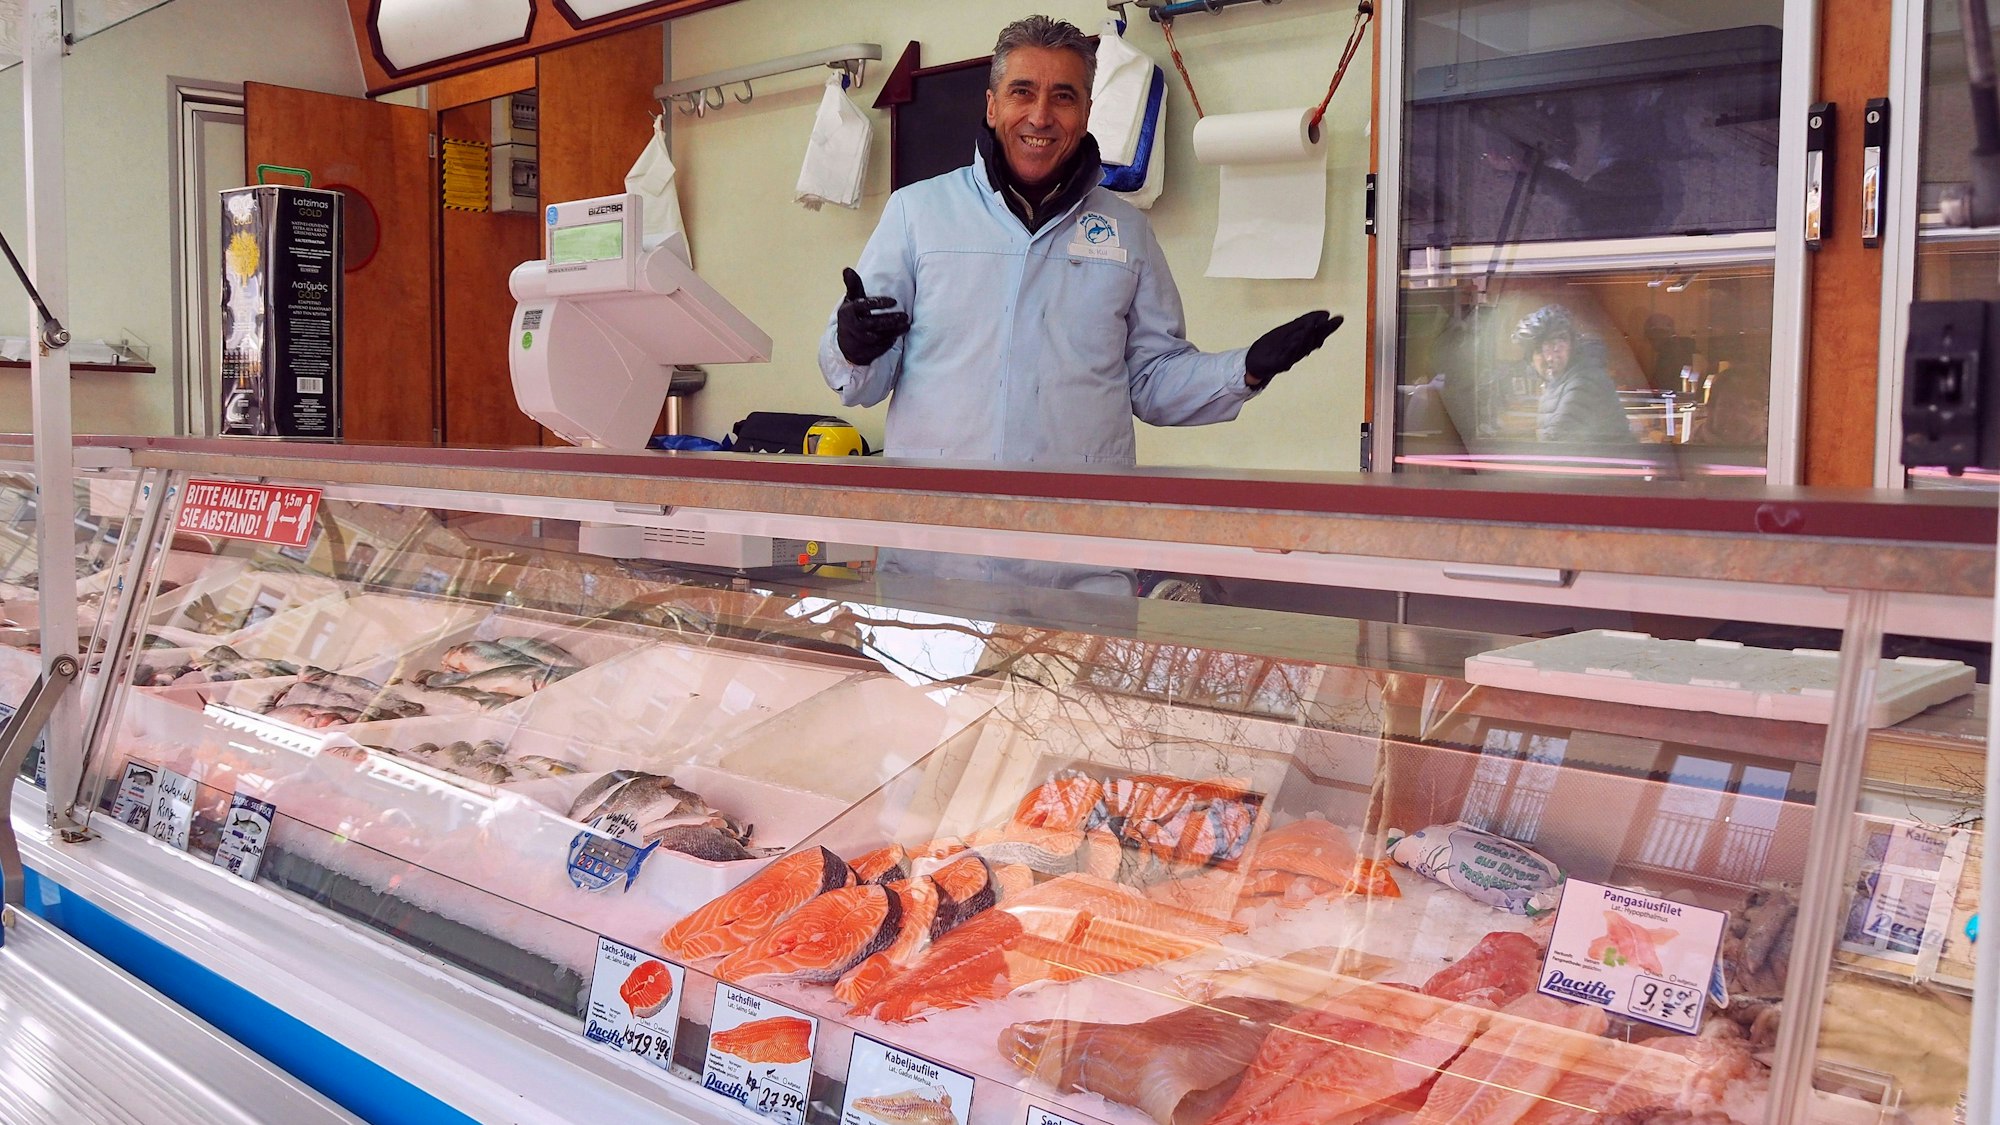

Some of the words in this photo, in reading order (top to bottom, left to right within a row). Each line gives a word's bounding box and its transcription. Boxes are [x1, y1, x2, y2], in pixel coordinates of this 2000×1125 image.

[293, 198, 329, 209] Latzimas
[299, 208, 323, 218] GOLD
[588, 204, 623, 216] BIZERBA
[291, 280, 328, 293] Λατζιμάς
[298, 290, 321, 299] GOLD
[186, 485, 220, 507] BITTE
[220, 487, 269, 511] HALTEN
[180, 508, 201, 528] SIE
[199, 509, 262, 536] ABSTAND!
[1603, 889, 1682, 917] Pangasiusfilet
[601, 941, 638, 962] Lachs-Steak
[1543, 969, 1616, 1000] Pacific
[727, 989, 761, 1011] Lachsfilet
[585, 1019, 624, 1047] Pacific
[885, 1050, 939, 1080] Kabeljaufilet
[703, 1071, 749, 1101] Pacific
